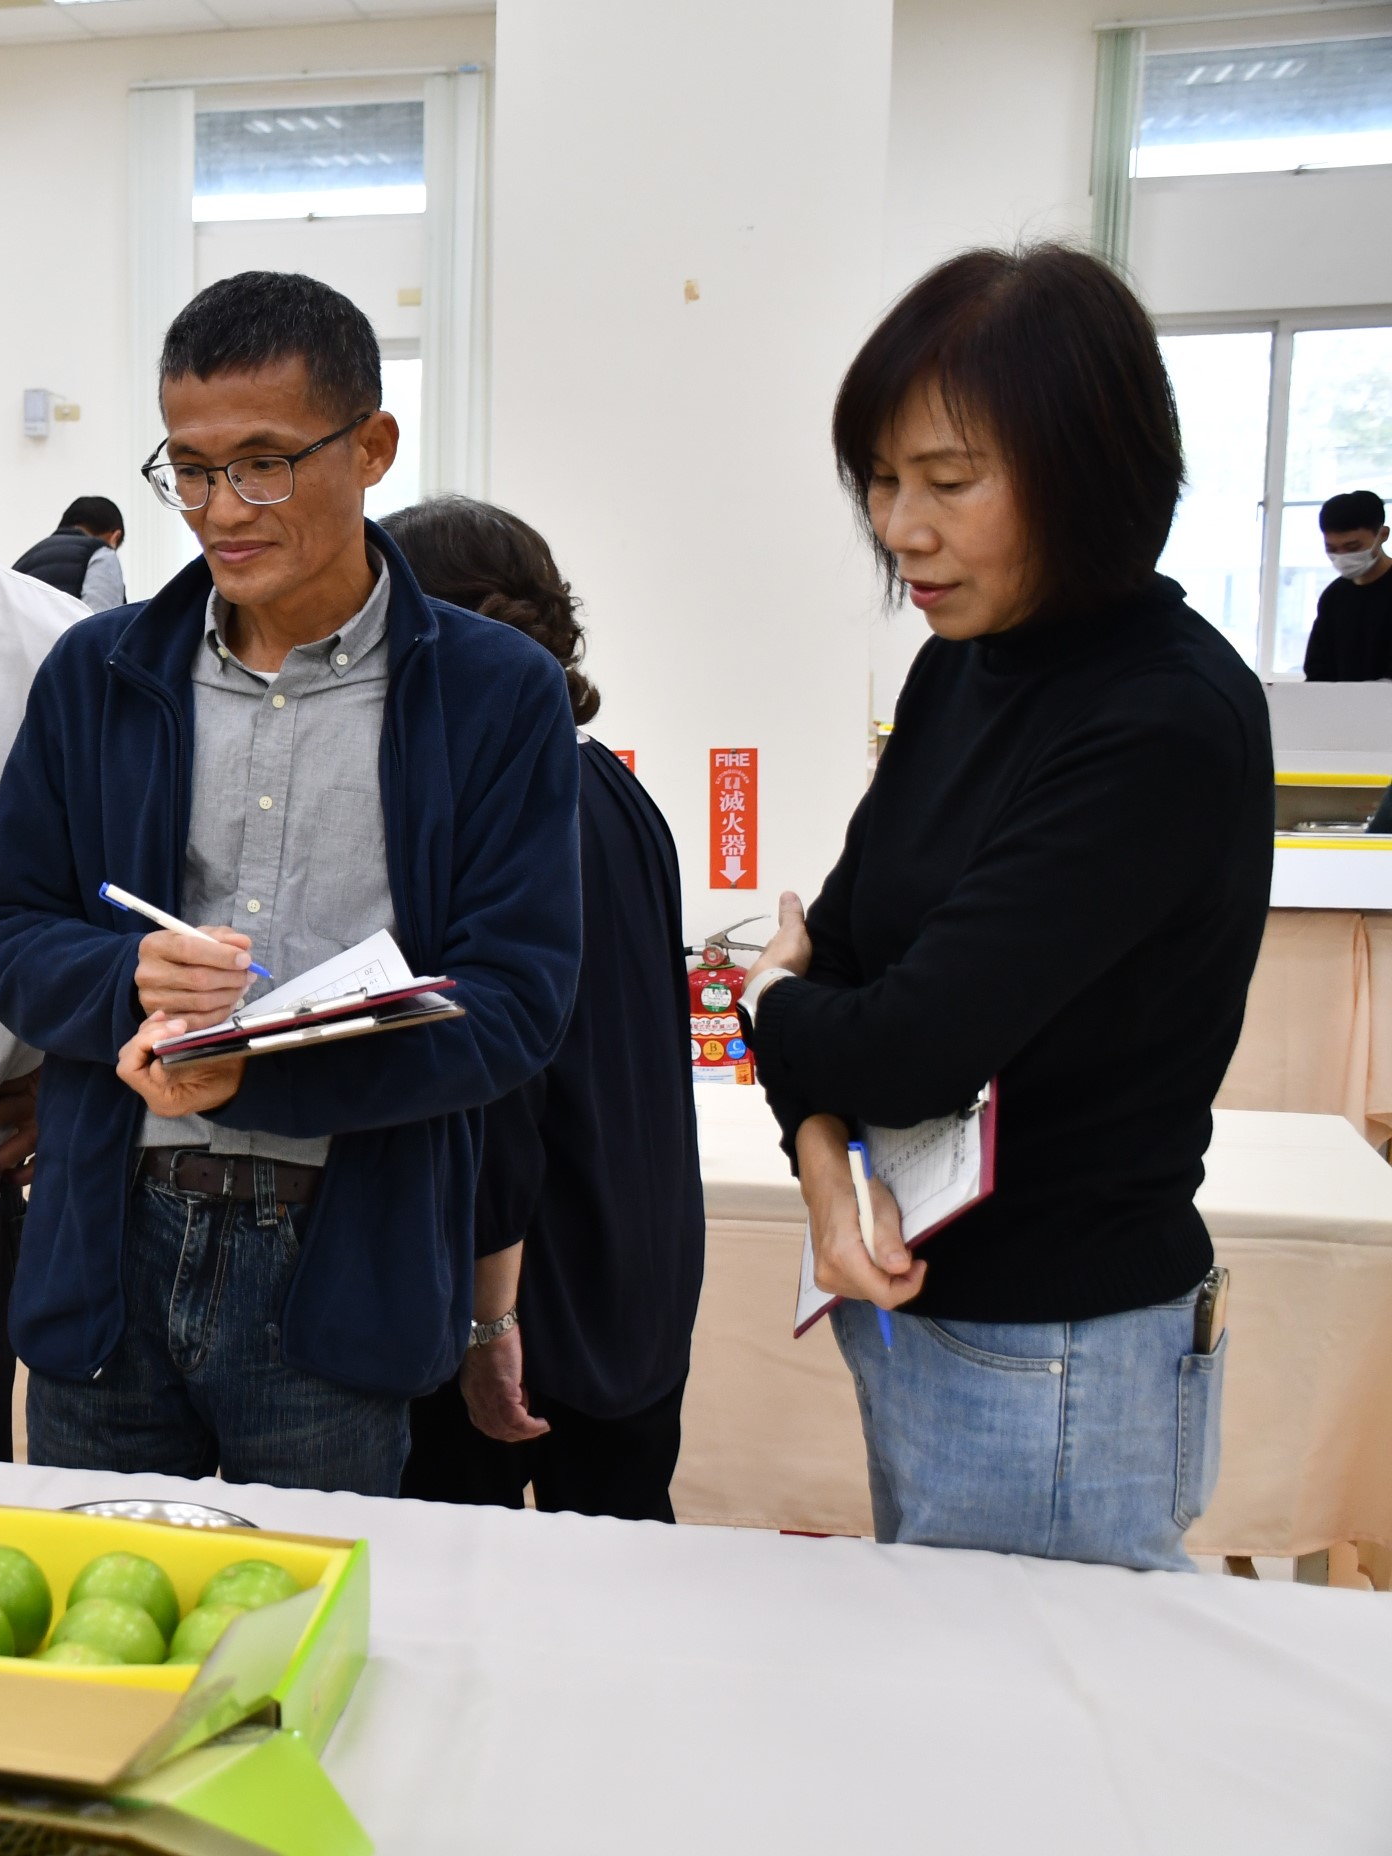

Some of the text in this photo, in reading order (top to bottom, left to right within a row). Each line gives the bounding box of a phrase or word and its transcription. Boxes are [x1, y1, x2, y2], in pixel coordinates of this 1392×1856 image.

[715, 753, 750, 767] FIRE
[719, 790, 746, 856] 滅火器
